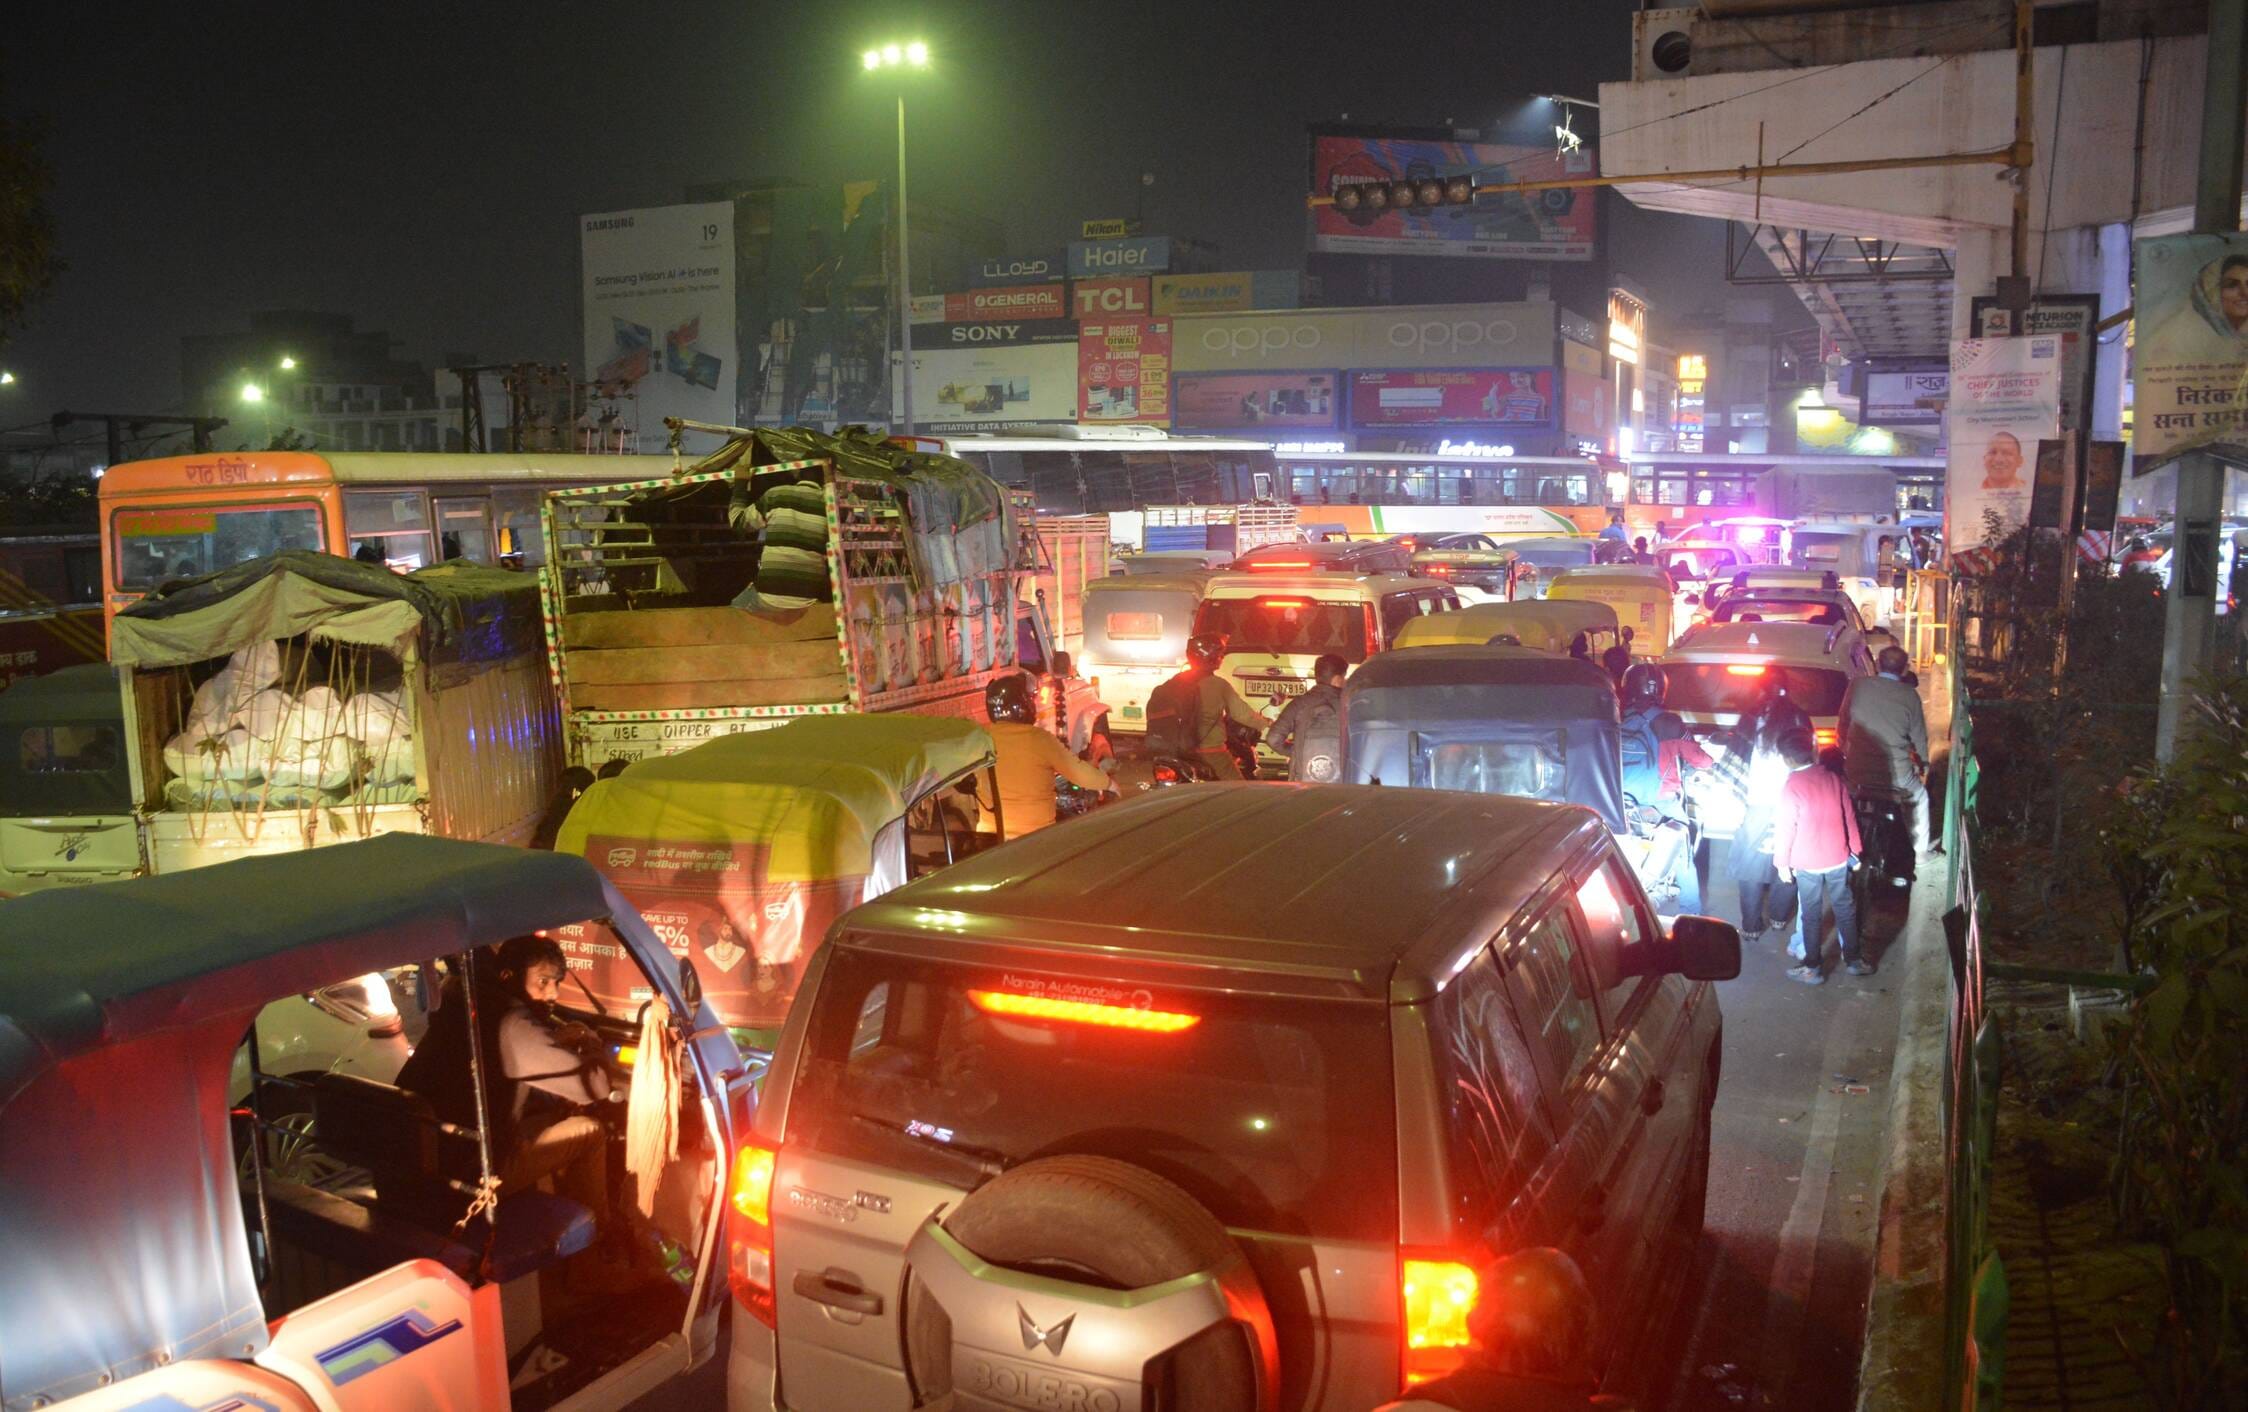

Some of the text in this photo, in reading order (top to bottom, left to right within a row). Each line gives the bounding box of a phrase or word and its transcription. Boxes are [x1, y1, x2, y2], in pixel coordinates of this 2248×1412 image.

[586, 217, 635, 232] SAMSUNG
[702, 224, 719, 241] 19
[1085, 223, 1121, 236] Nikon
[1085, 243, 1148, 268] Haier
[594, 275, 637, 286] Samsung
[638, 271, 667, 282] Vision
[696, 266, 720, 276] here
[983, 260, 1048, 278] LLOYD
[986, 292, 1058, 306] GENERAL
[1076, 287, 1145, 312] TCL
[951, 325, 1021, 342] SONY
[1108, 325, 1138, 337] BIGGEST
[1389, 320, 1518, 354] oppo
[1107, 336, 1139, 345] DIWALI
[1203, 325, 1321, 357] oppo
[1996, 378, 2041, 390] JUSTICES
[2003, 389, 2034, 398] WORLD
[930, 422, 976, 432] INITIATIVE
[977, 422, 1000, 431] DATA
[216, 456, 248, 484] डिपो
[613, 726, 639, 740] USE
[663, 725, 712, 738] DIPPER
[643, 860, 680, 870] redBus
[640, 912, 689, 925] SAVE UP TO
[653, 925, 690, 947] 5%
[578, 942, 617, 958] आपका
[564, 956, 594, 972] तज़ार
[975, 1360, 1121, 1412] BOLERO
